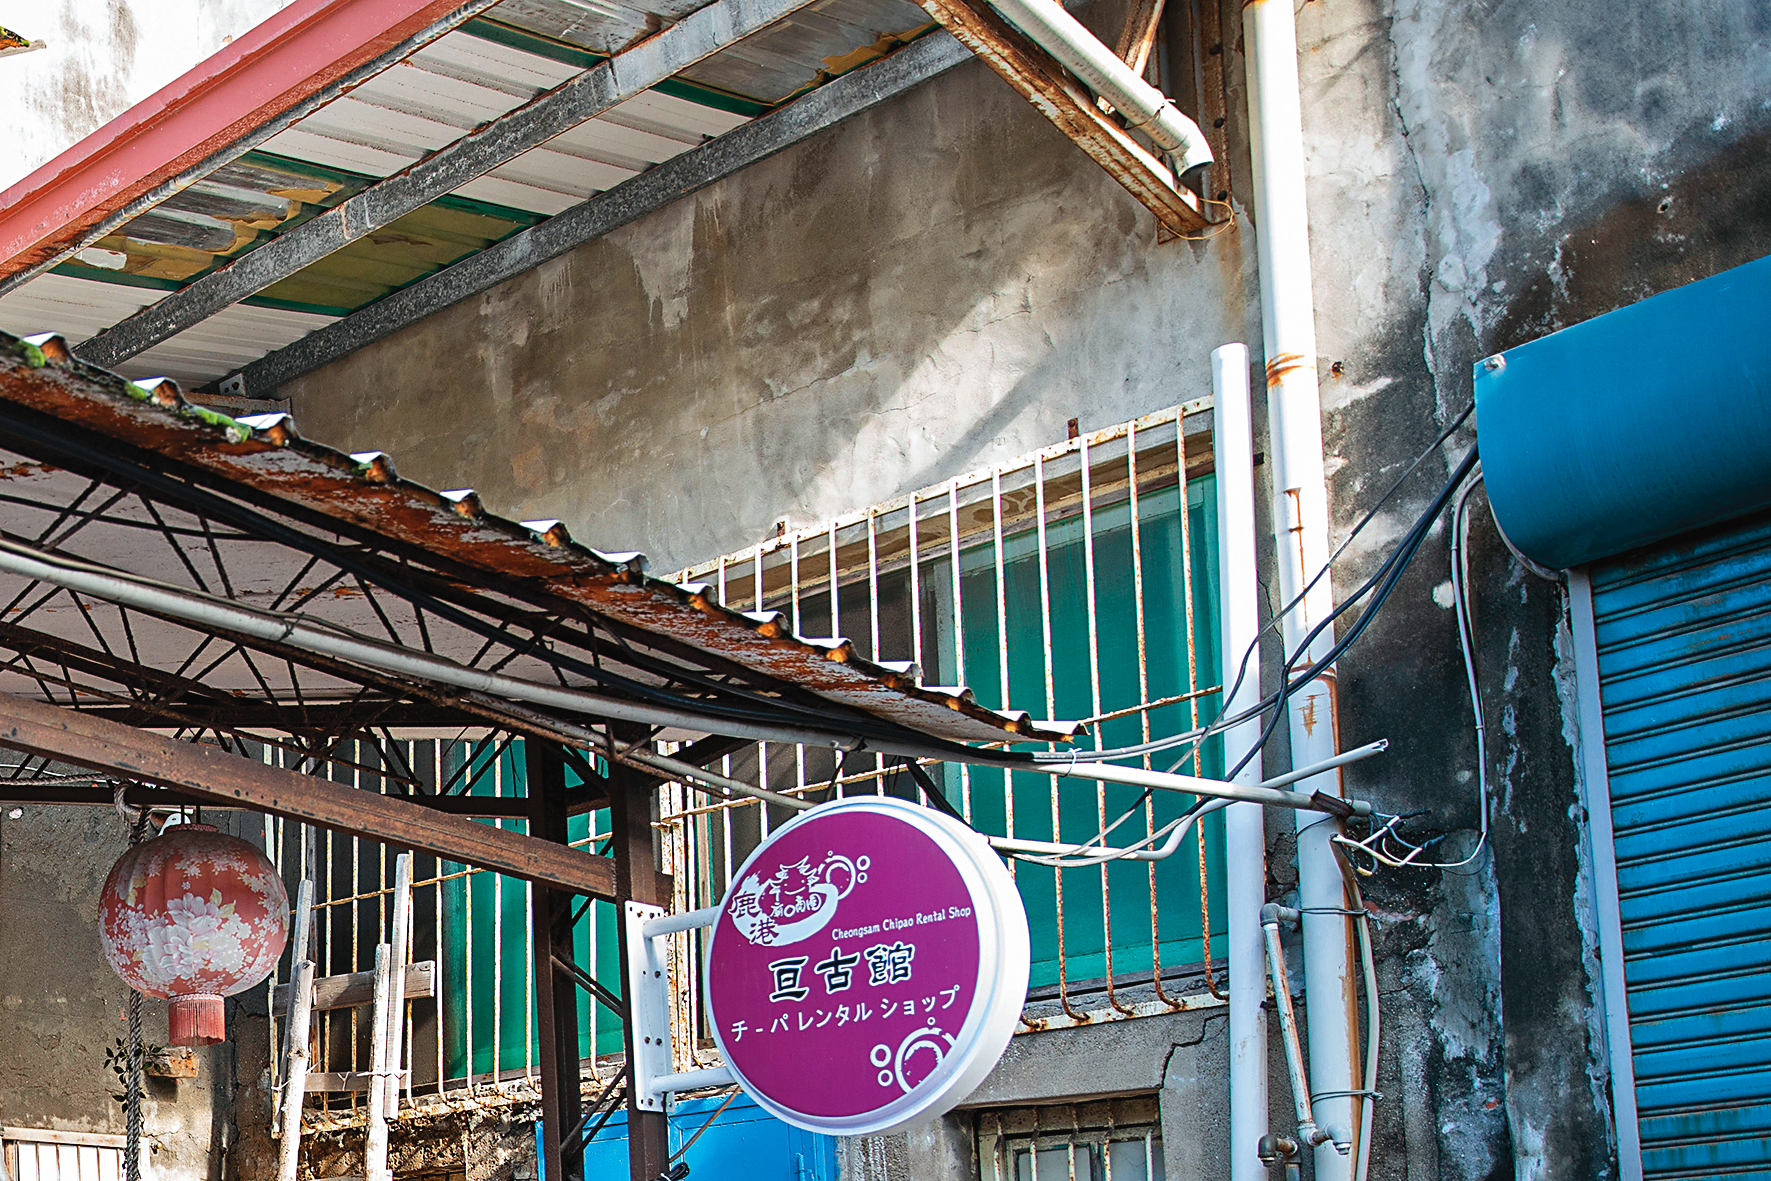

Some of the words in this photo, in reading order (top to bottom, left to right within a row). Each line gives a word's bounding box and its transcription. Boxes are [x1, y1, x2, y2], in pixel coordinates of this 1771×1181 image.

[832, 923, 880, 941] Cheongsam
[883, 917, 914, 931] Chipao
[916, 909, 946, 925] Rental
[948, 906, 971, 919] Shop
